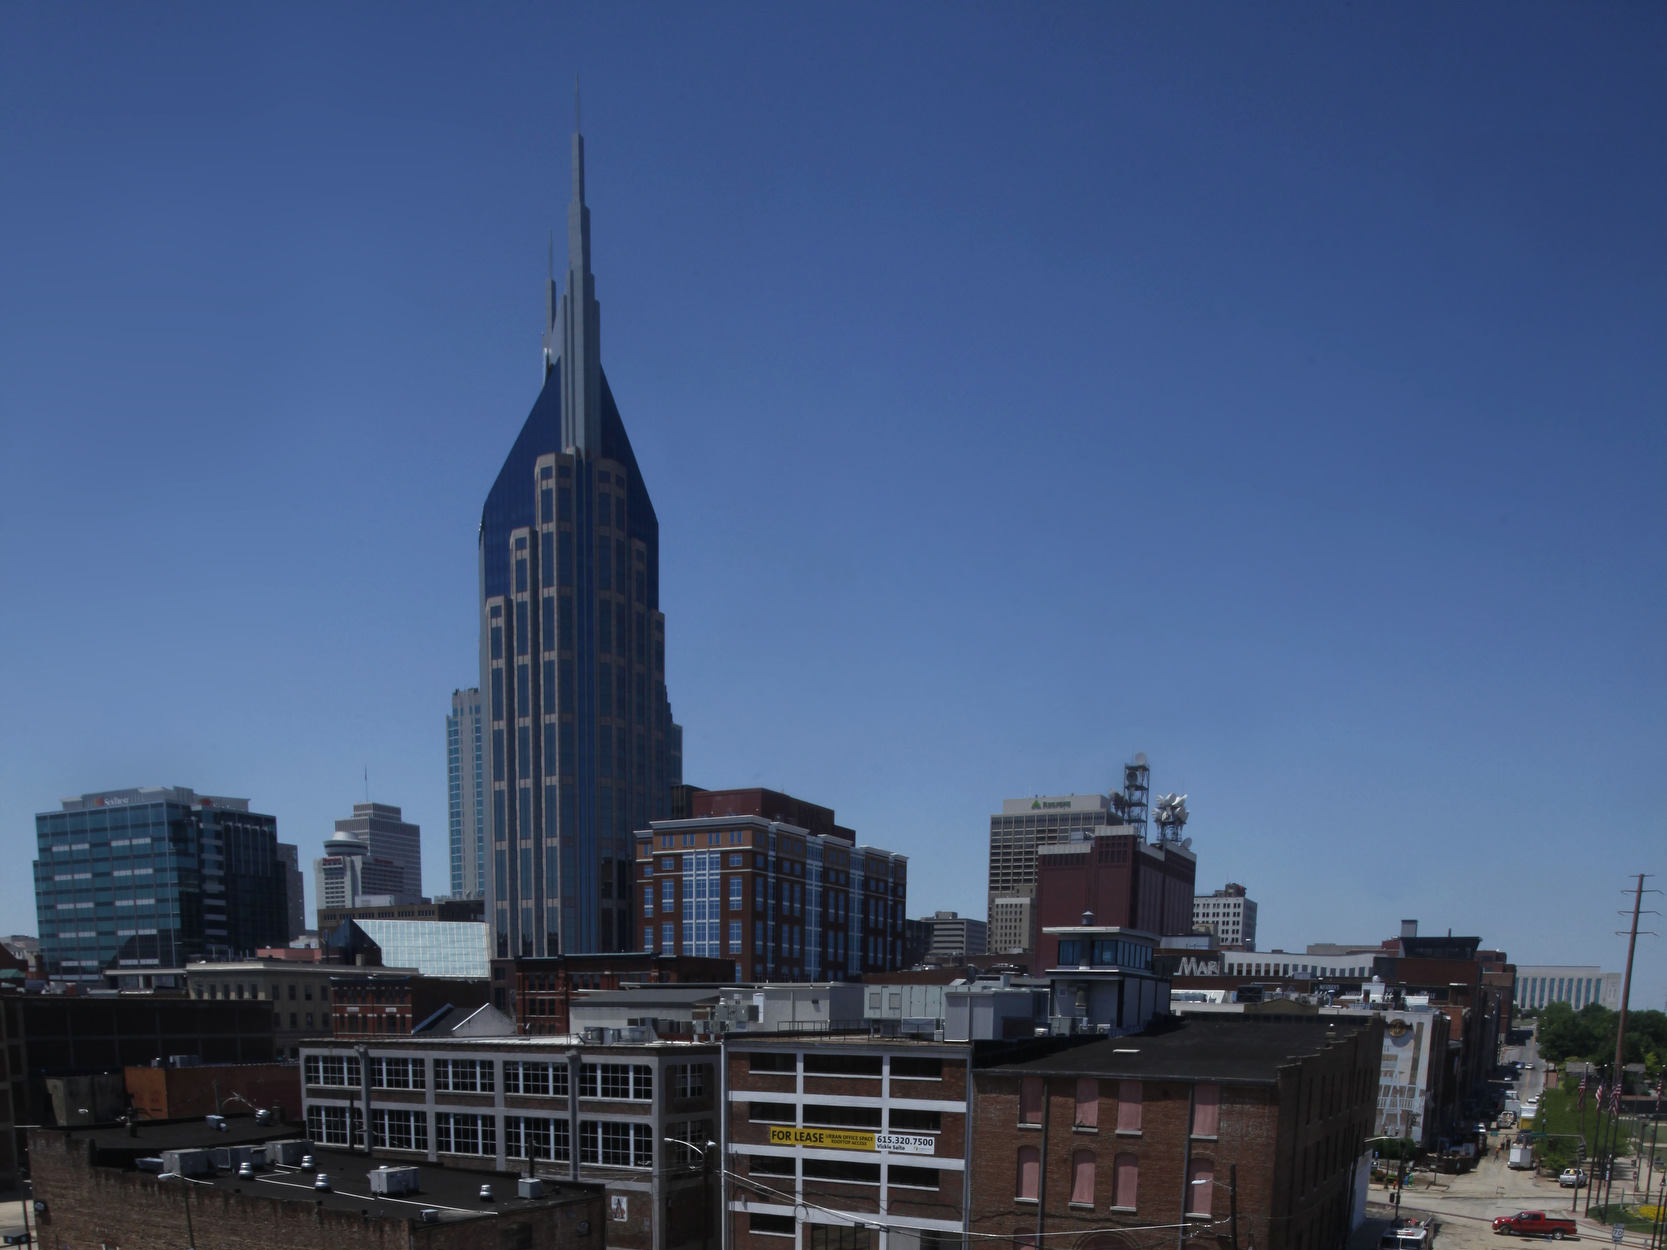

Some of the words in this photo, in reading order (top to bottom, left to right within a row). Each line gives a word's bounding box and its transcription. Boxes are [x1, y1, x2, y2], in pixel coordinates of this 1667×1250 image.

[771, 1130, 792, 1141] FOR
[794, 1131, 824, 1143] LEASE
[877, 1136, 933, 1147] 615.320.7500
